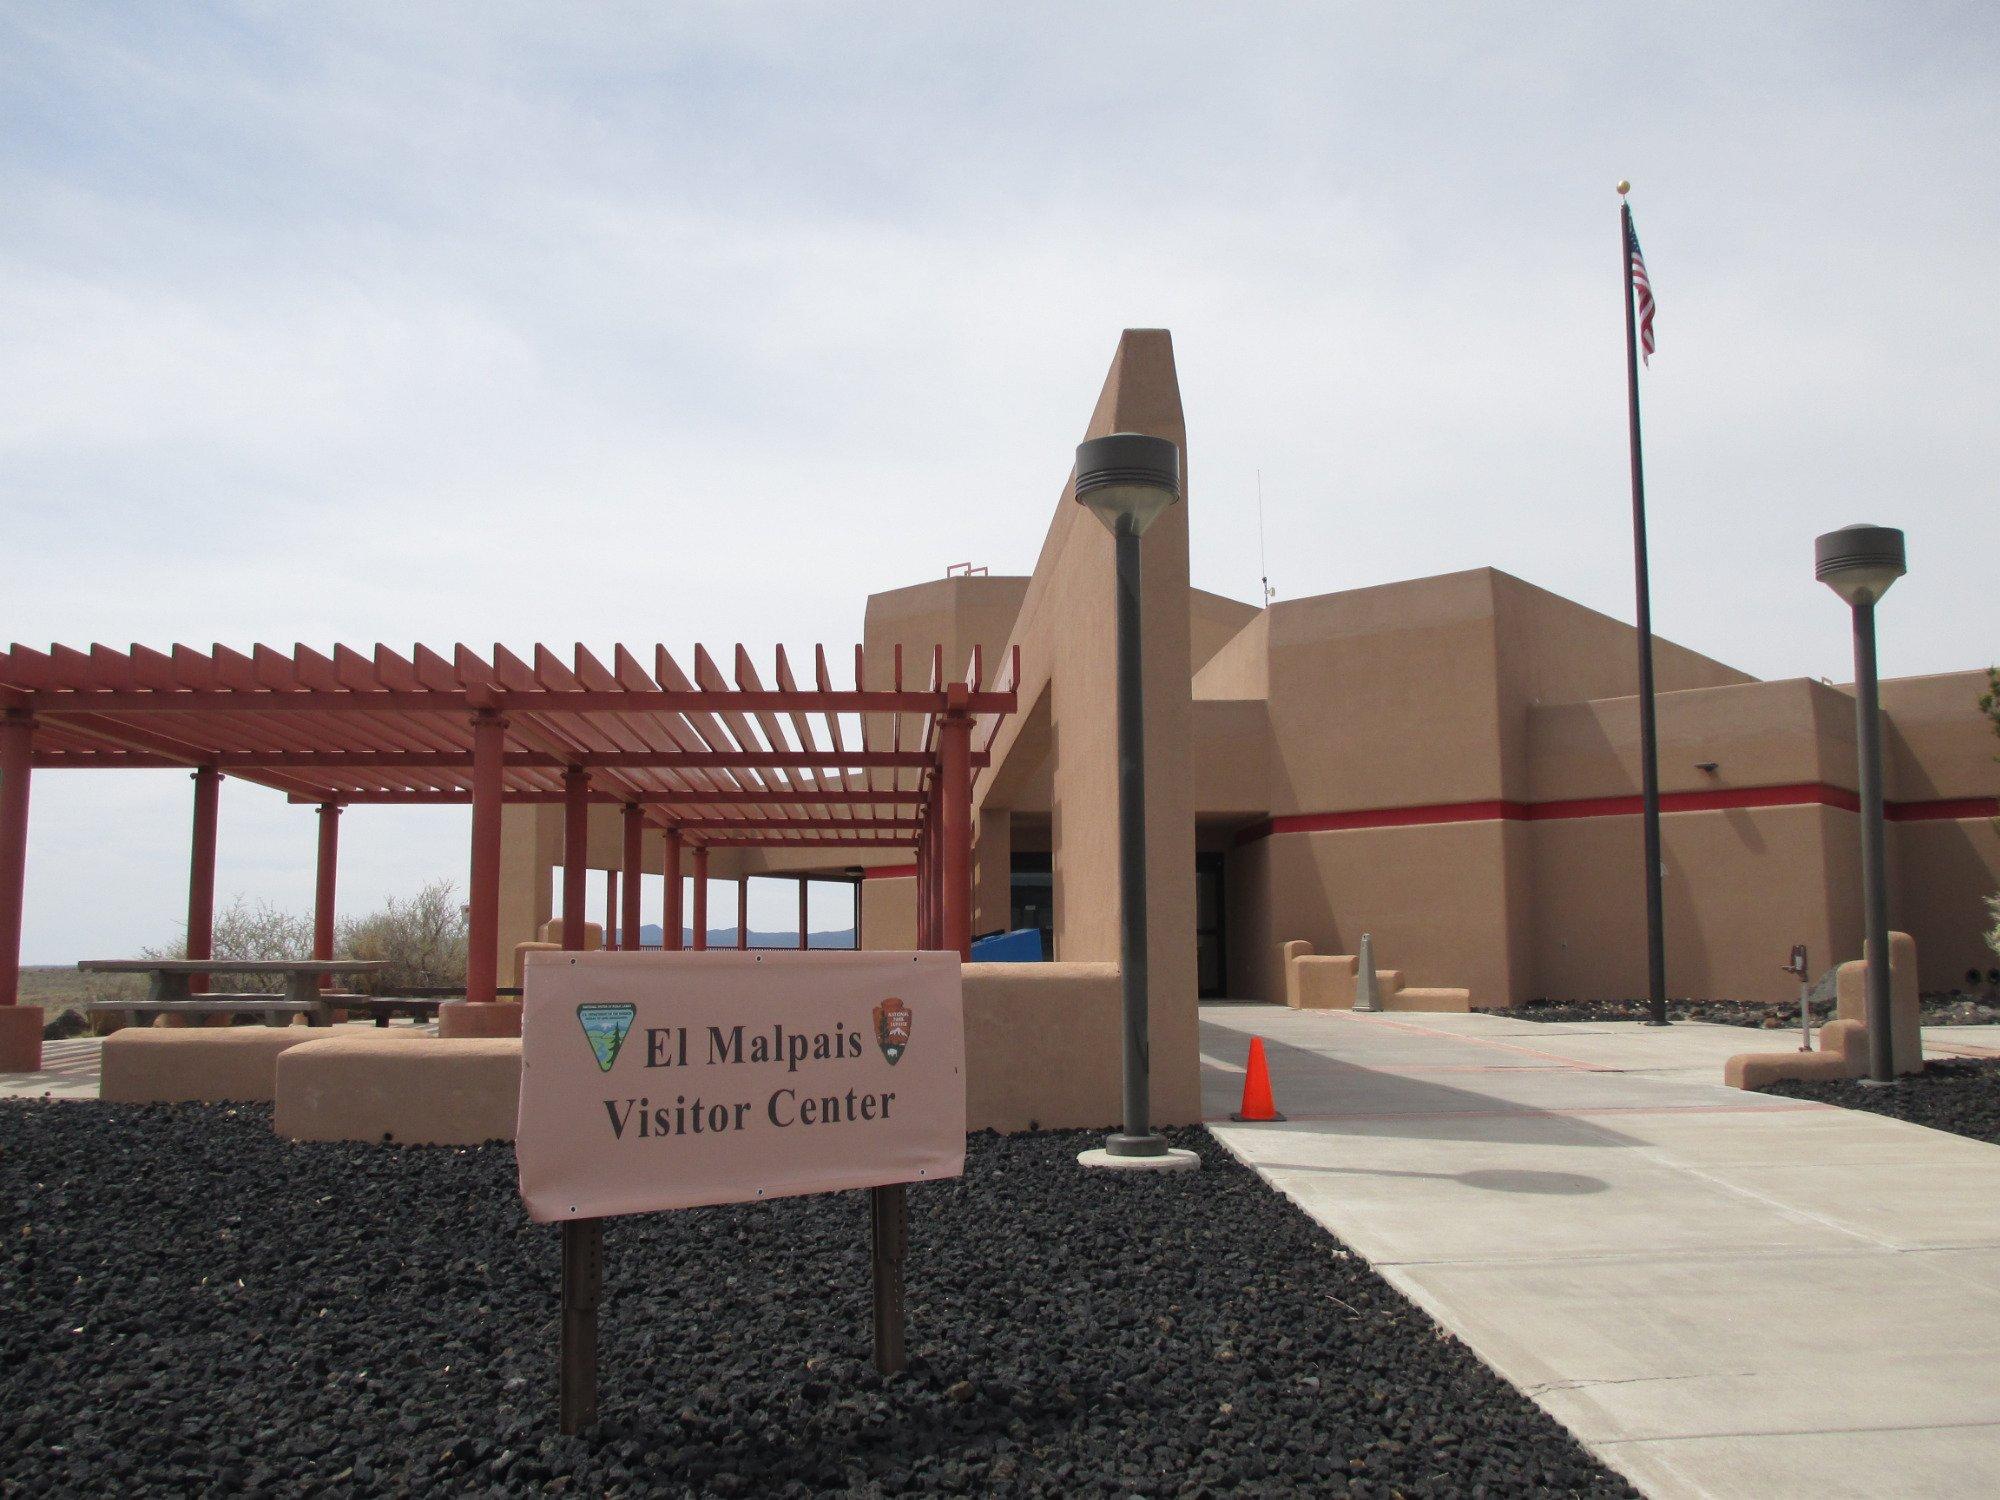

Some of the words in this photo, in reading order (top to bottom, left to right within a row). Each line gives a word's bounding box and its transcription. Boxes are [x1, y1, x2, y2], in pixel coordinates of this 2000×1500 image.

[644, 1027, 688, 1069] El
[706, 1022, 863, 1073] Malpais
[603, 1095, 752, 1141] Visitor
[767, 1088, 896, 1128] Center
